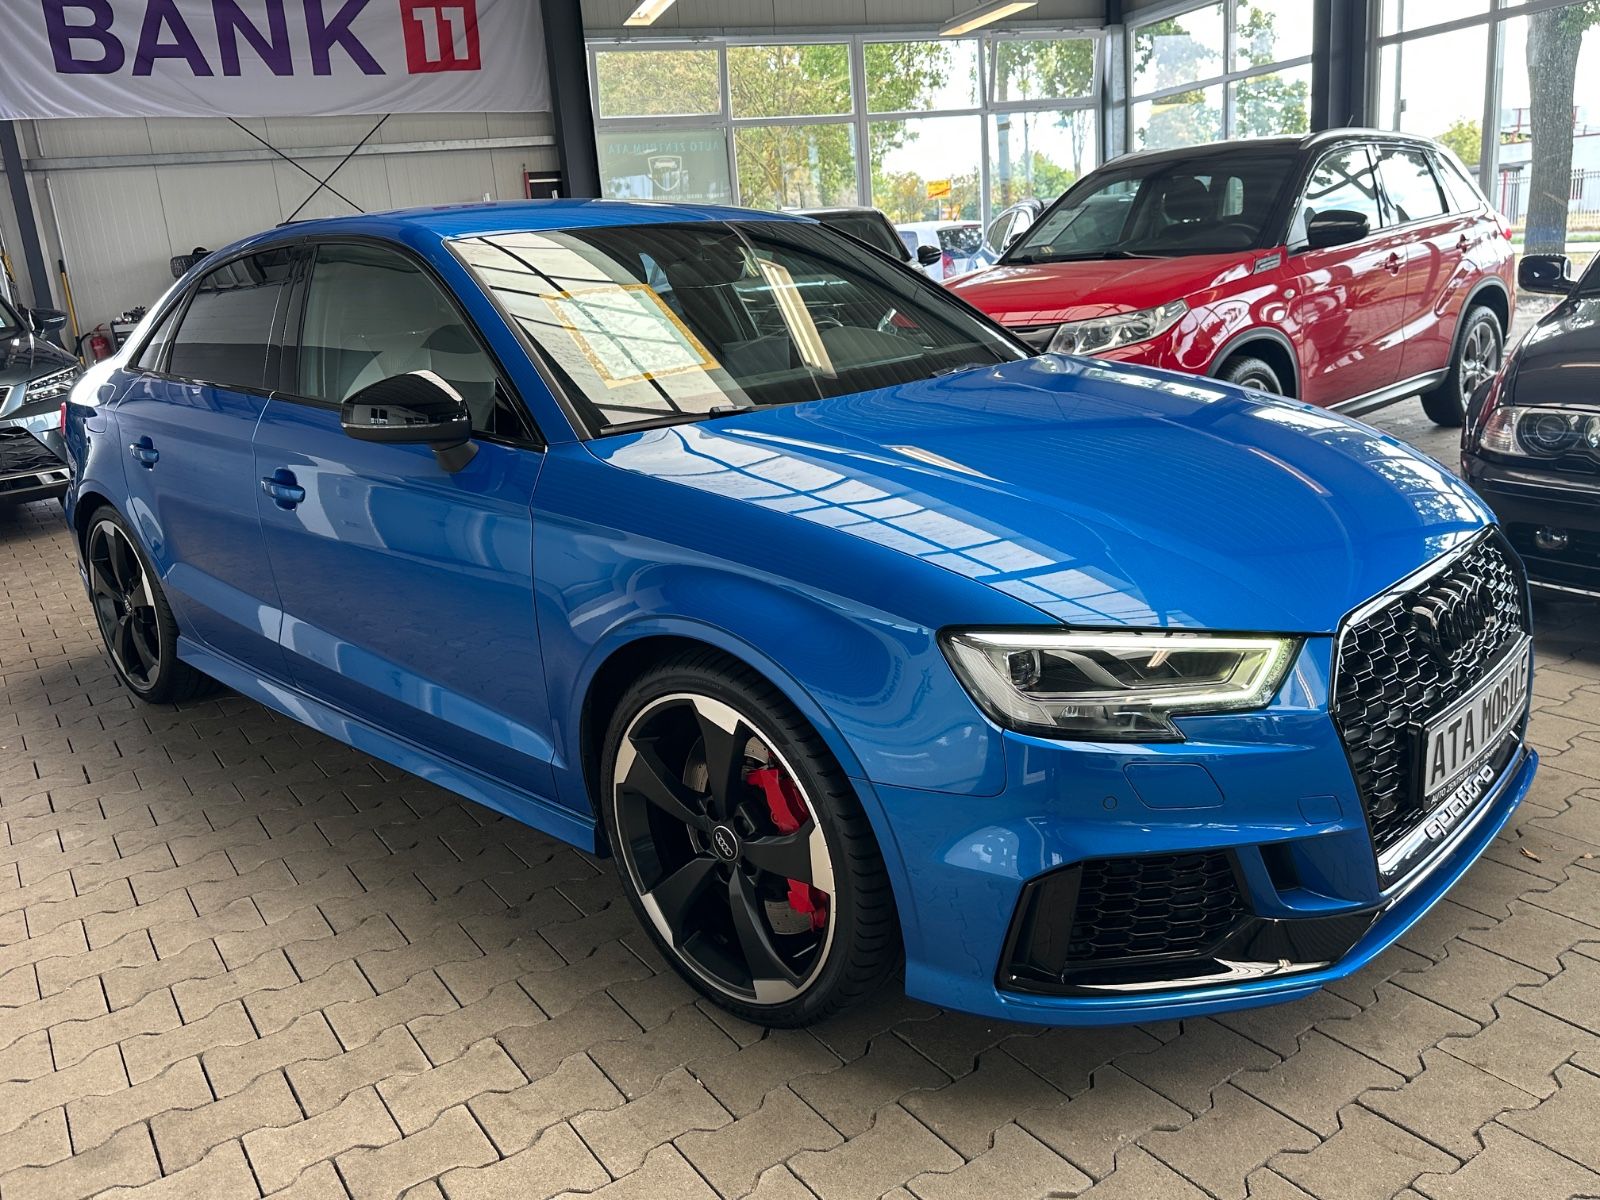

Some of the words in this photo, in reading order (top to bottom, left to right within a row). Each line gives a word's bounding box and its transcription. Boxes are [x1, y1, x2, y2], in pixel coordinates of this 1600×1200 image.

[42, 0, 387, 76] BANK
[413, 7, 469, 63] 11
[1430, 707, 1475, 786] ATA
[1482, 649, 1528, 746] MOBILE
[1425, 764, 1495, 840] quattro
[1430, 787, 1446, 805] AUTO
